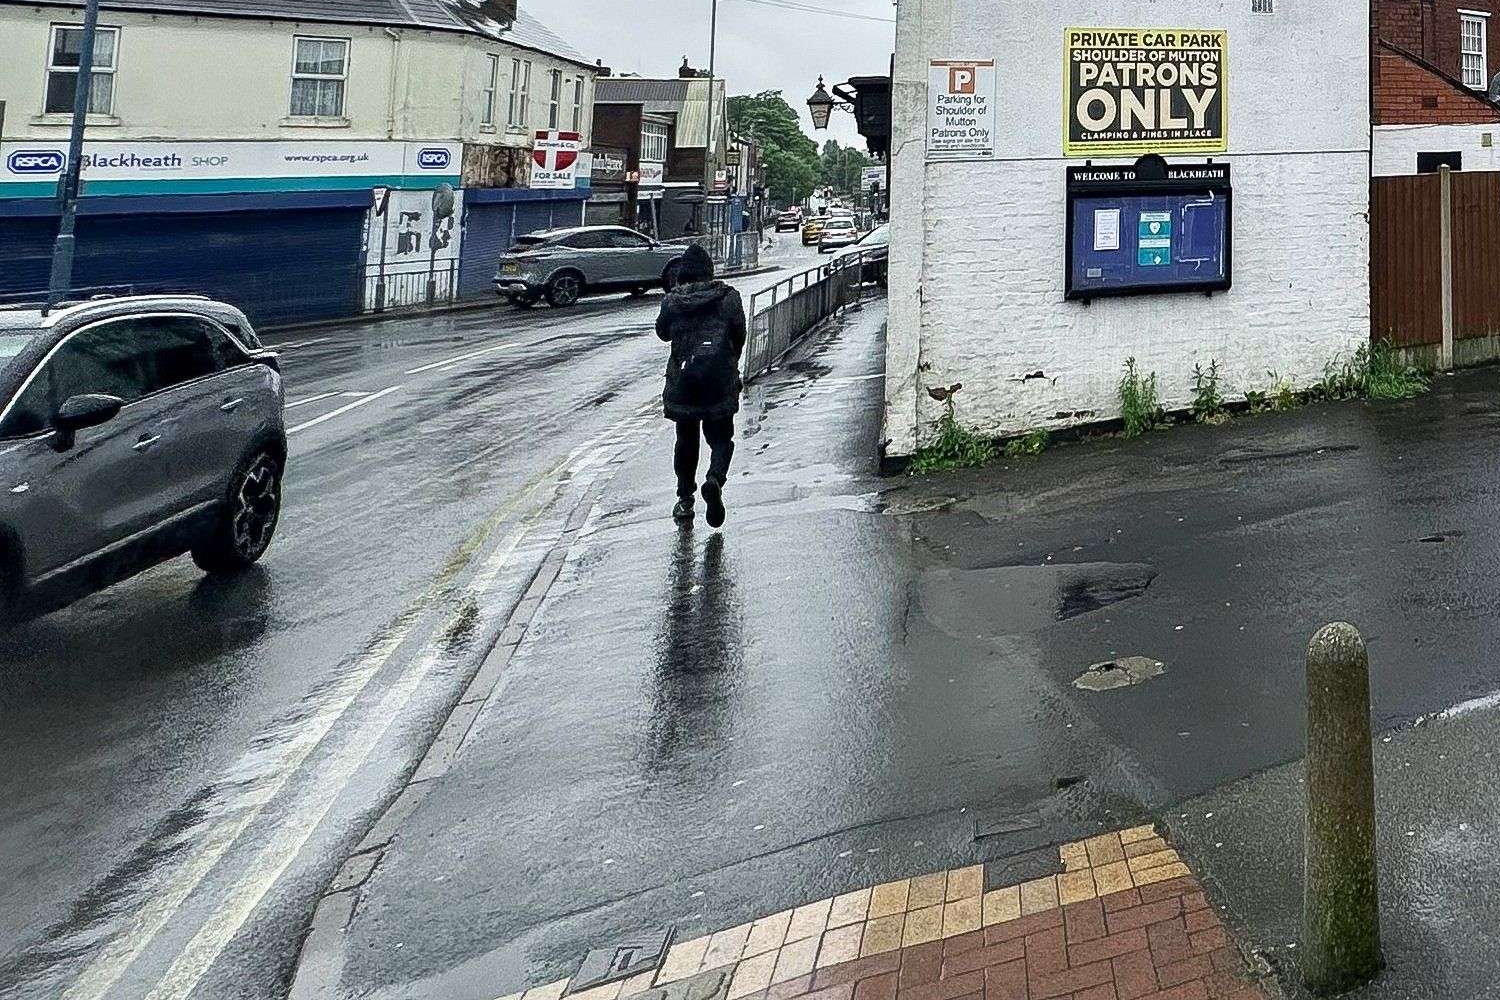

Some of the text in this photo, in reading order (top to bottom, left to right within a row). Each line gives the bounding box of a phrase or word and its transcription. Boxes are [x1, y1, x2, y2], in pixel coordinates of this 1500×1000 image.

[1070, 32, 1222, 48] PRIVATE CAR PARK
[1072, 50, 1219, 62] SHOULDER OF MUTTON
[1079, 62, 1218, 87] PATRONS
[955, 71, 972, 91] P
[937, 95, 986, 106] Parking for
[936, 106, 987, 115] Shoulder of
[1076, 88, 1217, 132] ONLY
[945, 117, 977, 126] Mutton
[932, 127, 989, 138] Patrons Only
[1081, 131, 1129, 140] CLAMPING
[1141, 130, 1168, 139] FINES
[1171, 130, 1181, 138] IN
[1184, 130, 1212, 138] PLACE
[15, 157, 59, 168] RSPCA
[81, 153, 229, 168] Blackheath SHOP
[284, 153, 370, 164] www.rspca.org.uk
[534, 172, 551, 180] FOR
[1074, 169, 1224, 181] WELCOME TO BLACKHEATH
